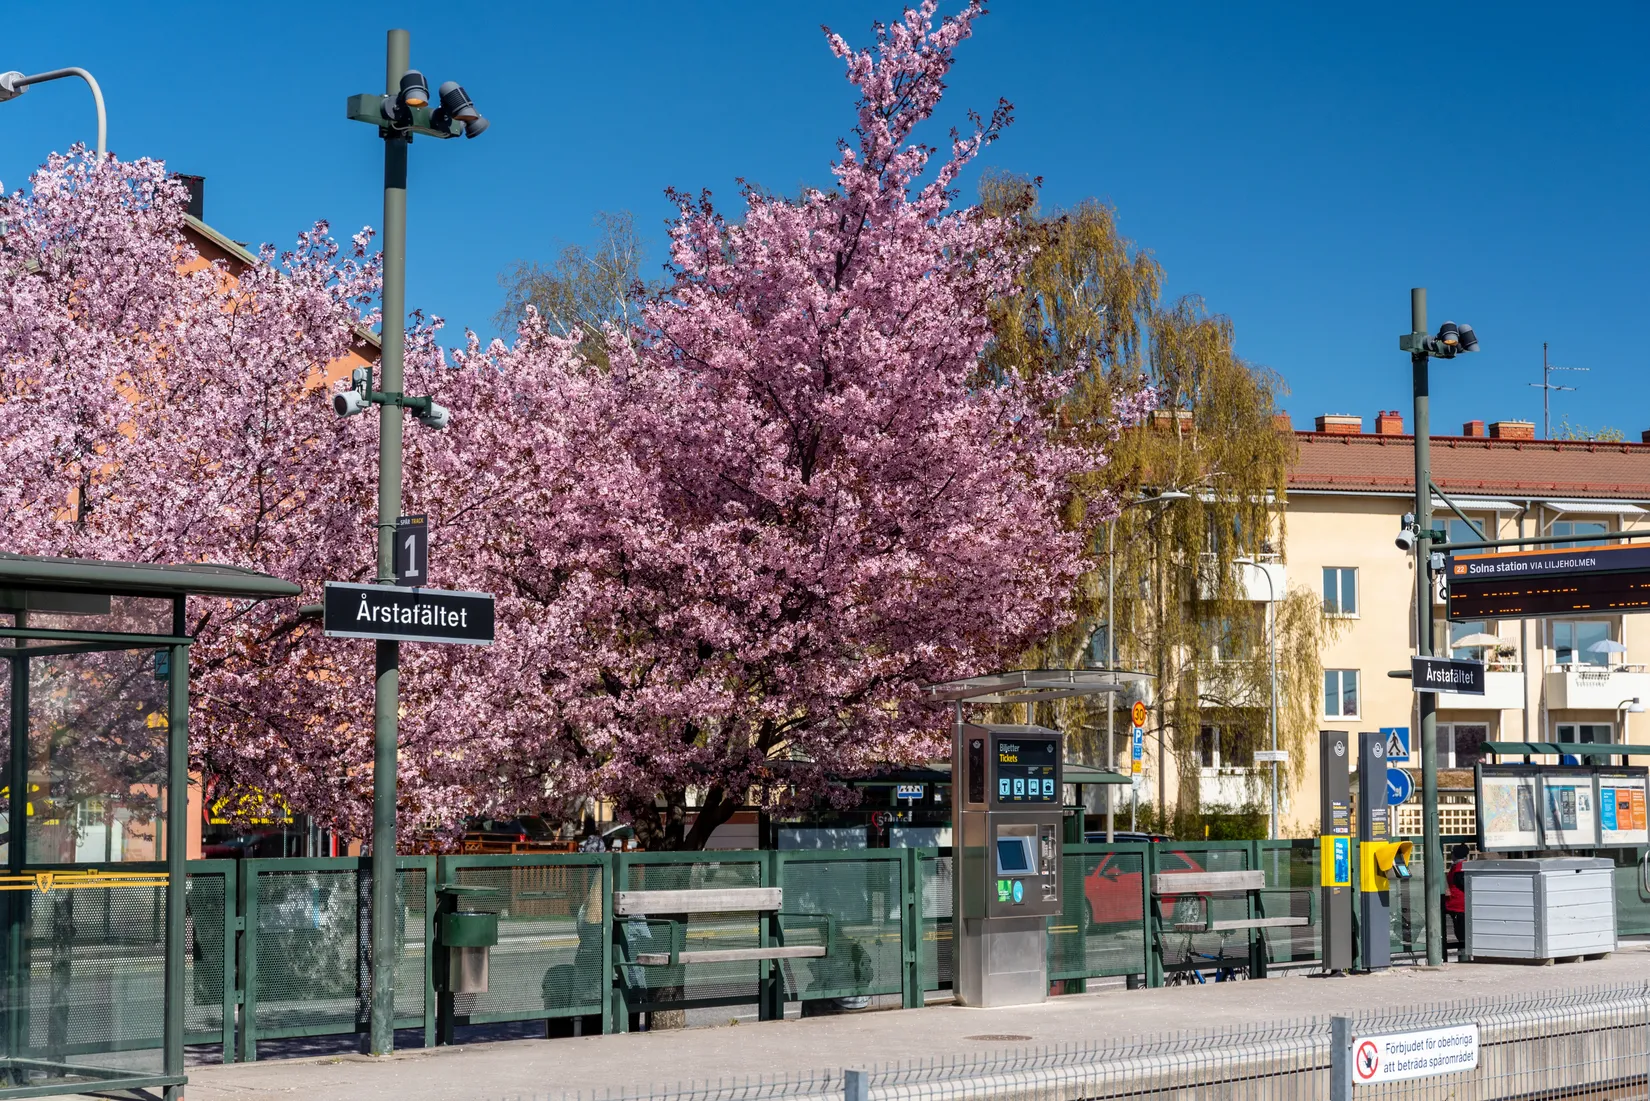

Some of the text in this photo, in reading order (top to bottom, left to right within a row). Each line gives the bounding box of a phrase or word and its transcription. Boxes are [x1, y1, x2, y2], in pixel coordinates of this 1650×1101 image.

[411, 517, 424, 525] TRACK
[404, 534, 419, 578] 1
[1456, 558, 1596, 574] 22 Solna station VIA LILJEHOLMEN
[356, 593, 468, 628] Årstafältet
[1426, 662, 1474, 685] Årstafältet
[1135, 708, 1144, 721] 30
[1135, 729, 1142, 743] P
[999, 743, 1020, 753] Biljetter
[999, 753, 1018, 763] Tickets
[1386, 1034, 1473, 1056] Förbjudet för obehöriga
[1384, 1051, 1474, 1073] att beträda spårområdet
